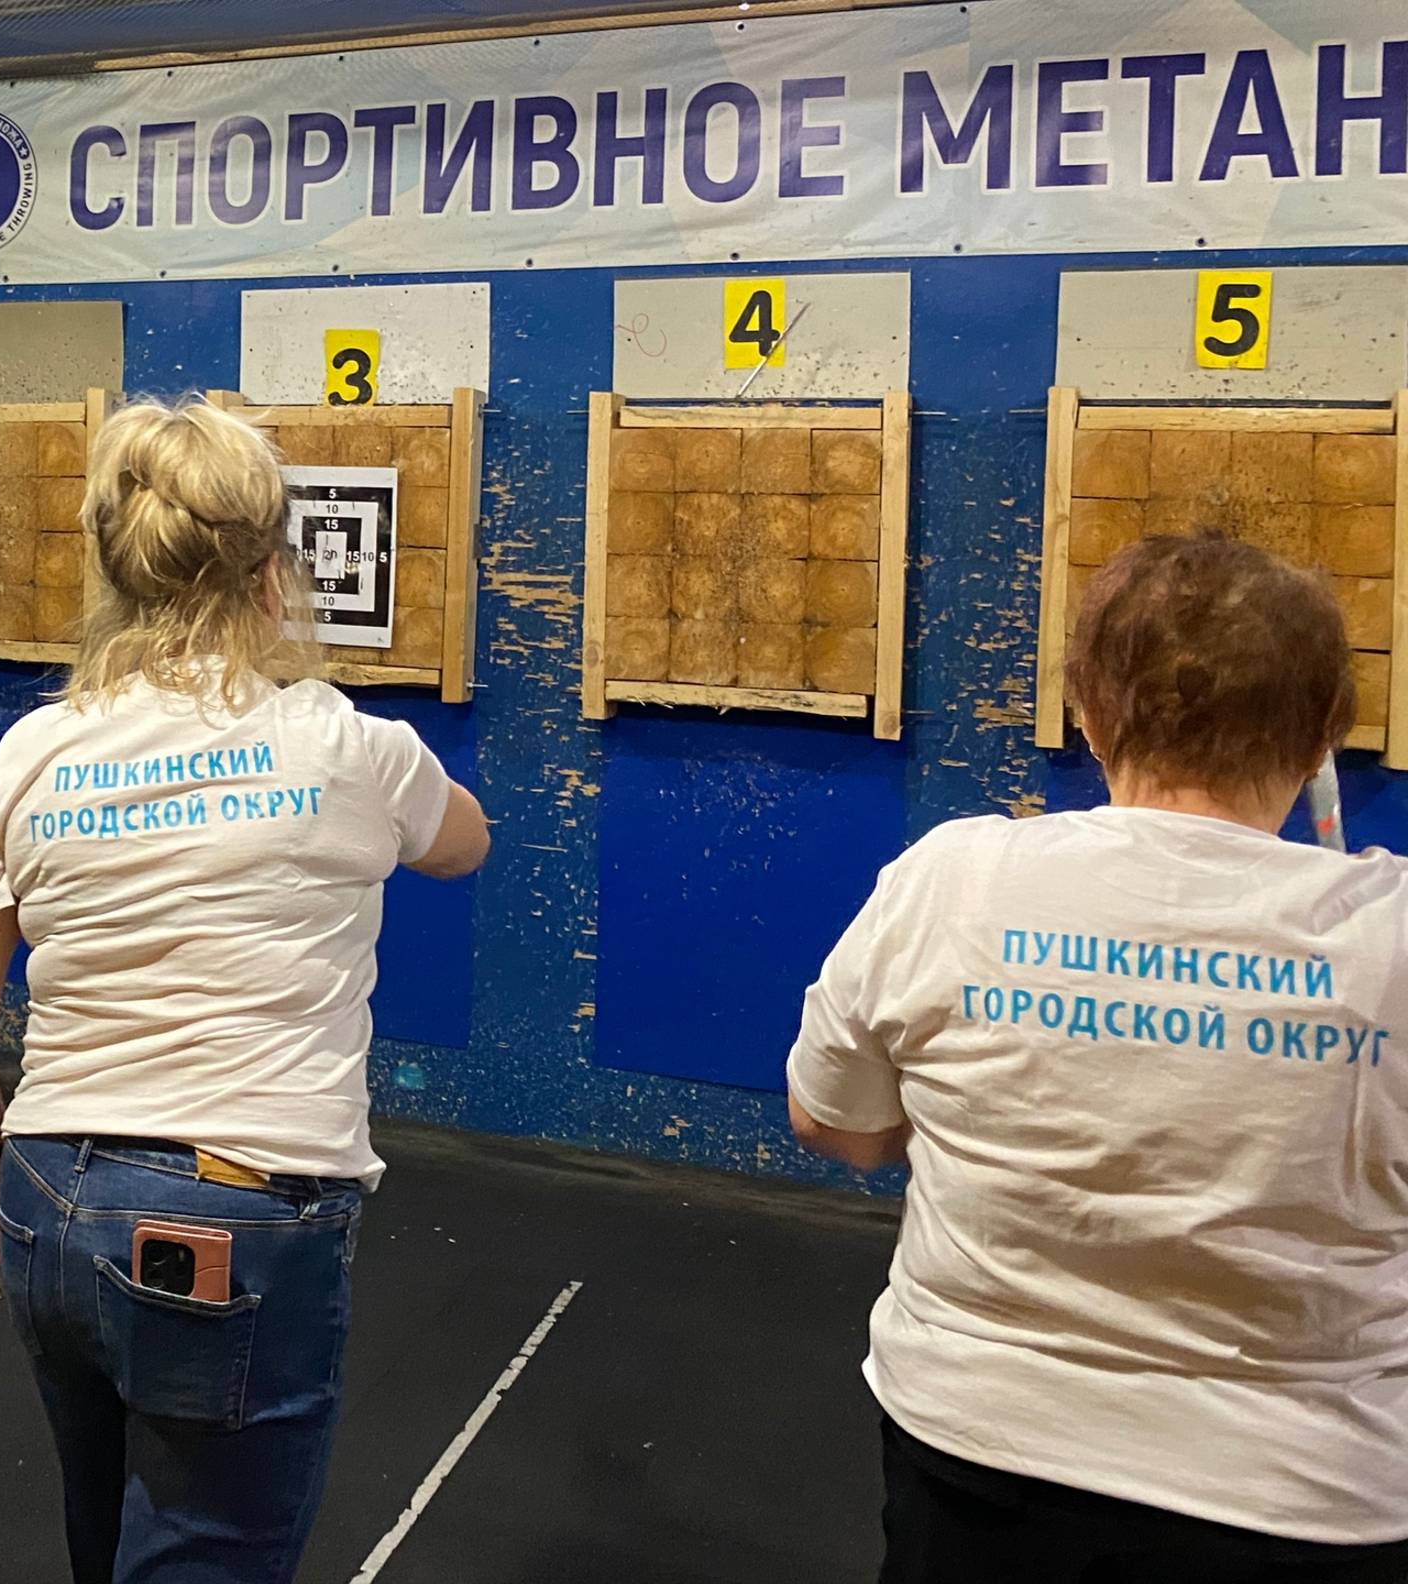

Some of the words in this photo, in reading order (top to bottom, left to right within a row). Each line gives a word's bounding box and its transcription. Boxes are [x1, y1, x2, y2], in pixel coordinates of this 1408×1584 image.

[69, 76, 846, 230] СПОРТИВНОЕ
[899, 41, 1408, 193] МЕТАН
[7, 163, 34, 232] THROWING
[729, 290, 781, 357] 4
[1203, 283, 1262, 356] 5
[328, 348, 373, 406] 3
[326, 504, 339, 515] 10
[328, 488, 337, 499] 5
[324, 519, 339, 530] 15
[346, 550, 360, 562] 15
[362, 551, 375, 562] 10
[379, 552, 388, 563] 5
[321, 596, 335, 607] 10
[322, 580, 337, 592] 15
[324, 611, 332, 622] 5
[54, 740, 275, 792] ПУШКИНСКИЙ
[29, 793, 208, 843] ГОРОДСКОЙ
[220, 787, 323, 822] ОКРУГ
[1002, 929, 1334, 999] ПУШКИНСКИЙ
[962, 984, 1226, 1051] ГОРОДСКОЙ
[1246, 1017, 1390, 1067] ОКРУГ
